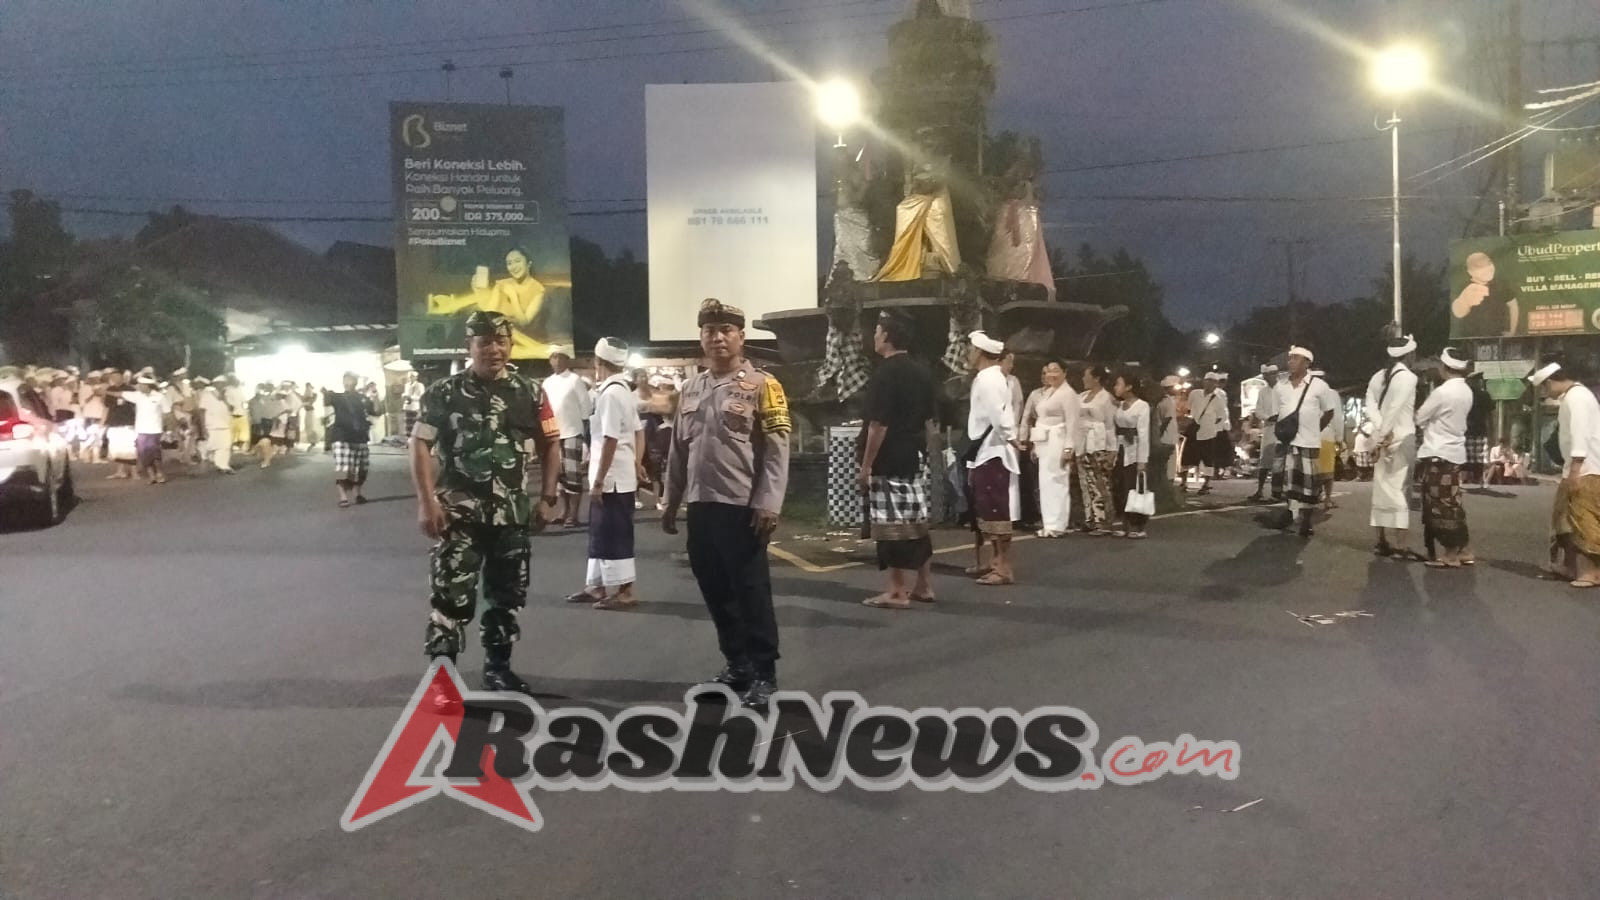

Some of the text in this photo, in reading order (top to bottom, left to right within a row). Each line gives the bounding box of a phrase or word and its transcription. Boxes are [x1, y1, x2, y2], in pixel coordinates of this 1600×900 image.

[404, 158, 527, 171] Beri Koneksi Lebih.
[432, 184, 474, 196] Banyak
[412, 208, 440, 220] 200
[464, 212, 524, 221] IDR 375,000
[1520, 284, 1548, 292] VILLA
